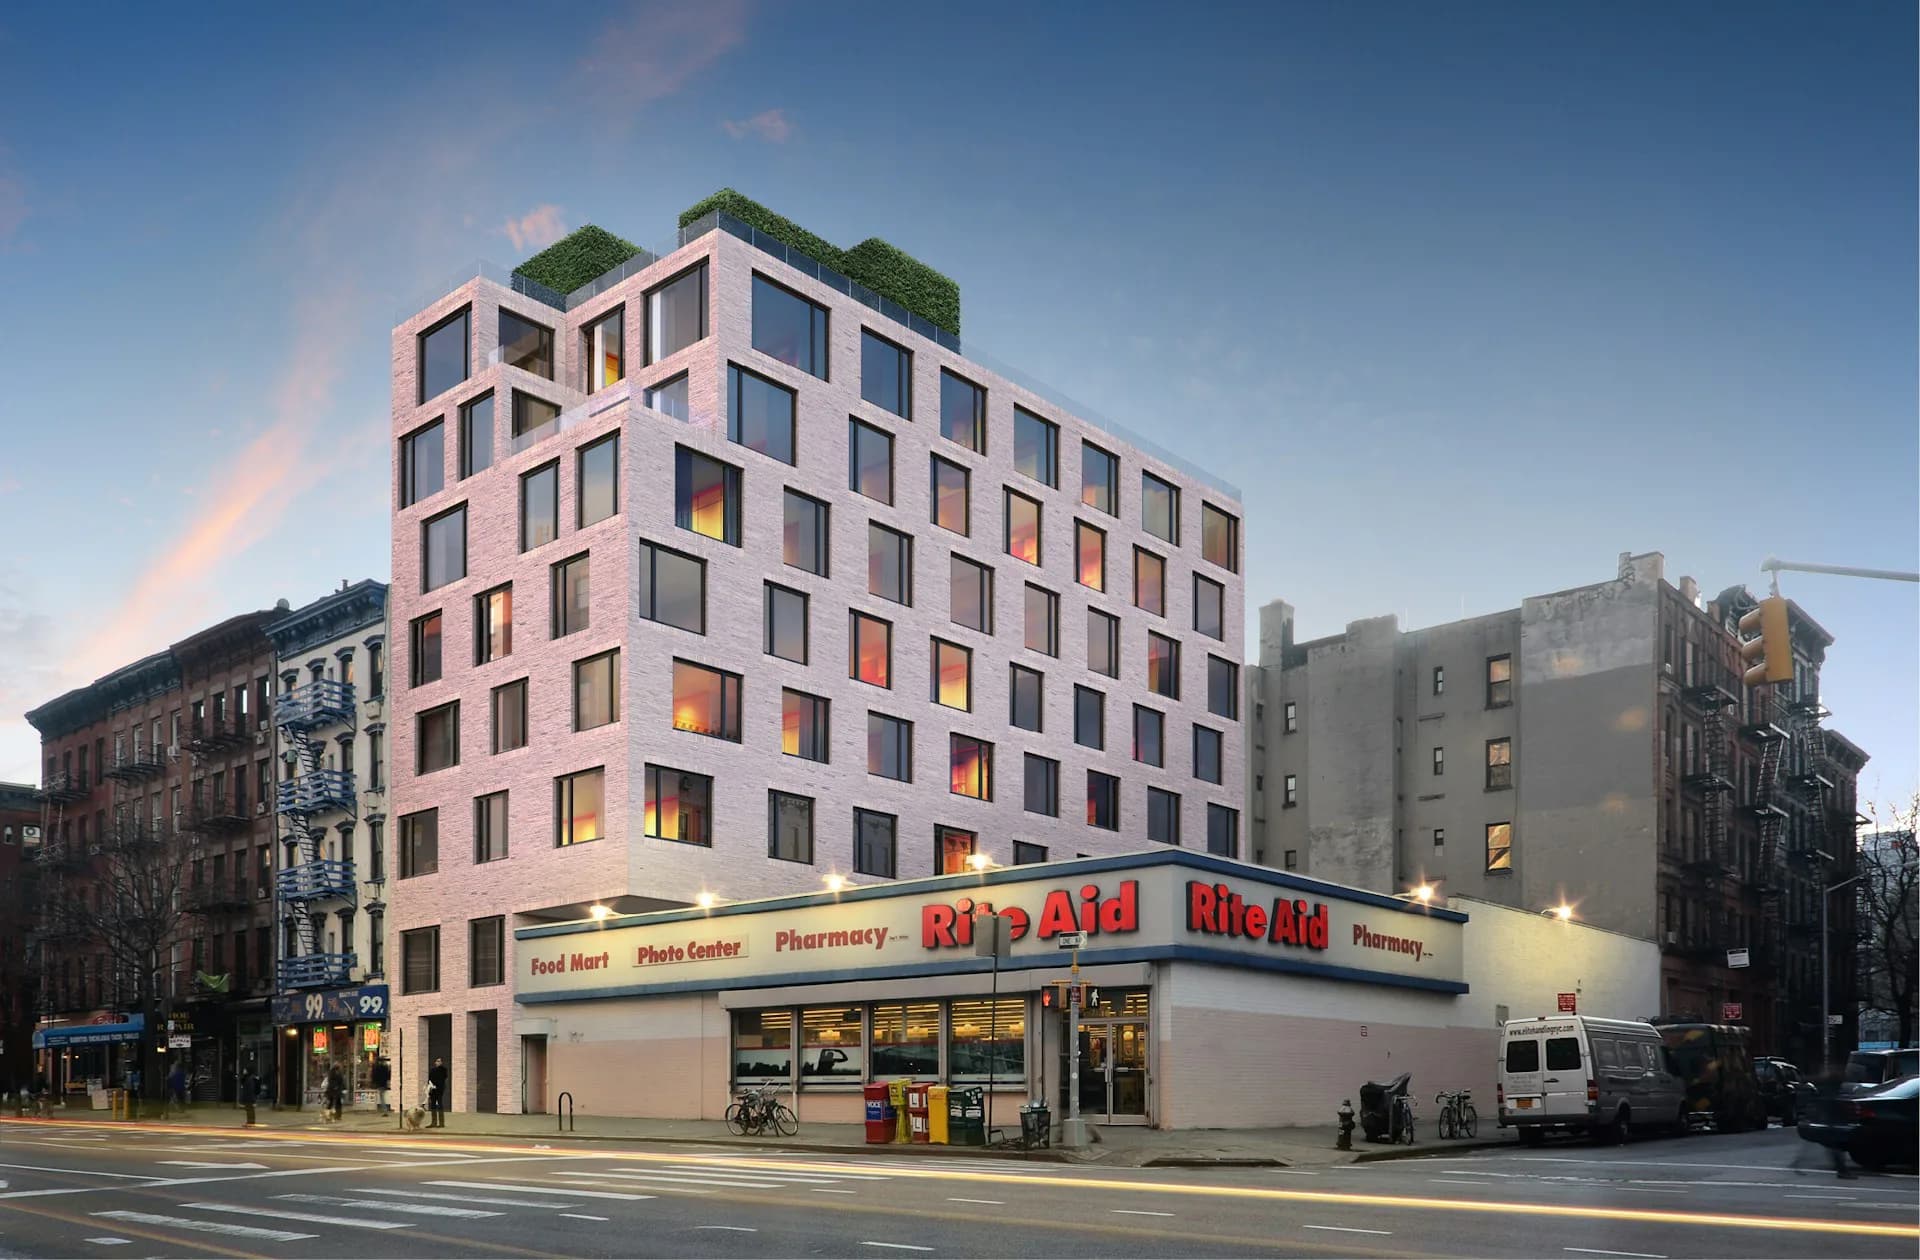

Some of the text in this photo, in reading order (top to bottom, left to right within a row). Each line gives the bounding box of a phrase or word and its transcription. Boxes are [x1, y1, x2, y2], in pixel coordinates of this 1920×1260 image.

[1037, 880, 1139, 938] Aid
[1187, 881, 1328, 950] Rite Aid
[637, 940, 742, 965] Photo Center
[775, 926, 889, 953] Pharmacy
[1352, 923, 1424, 961] Pharmacy
[531, 951, 609, 976] Food Mart
